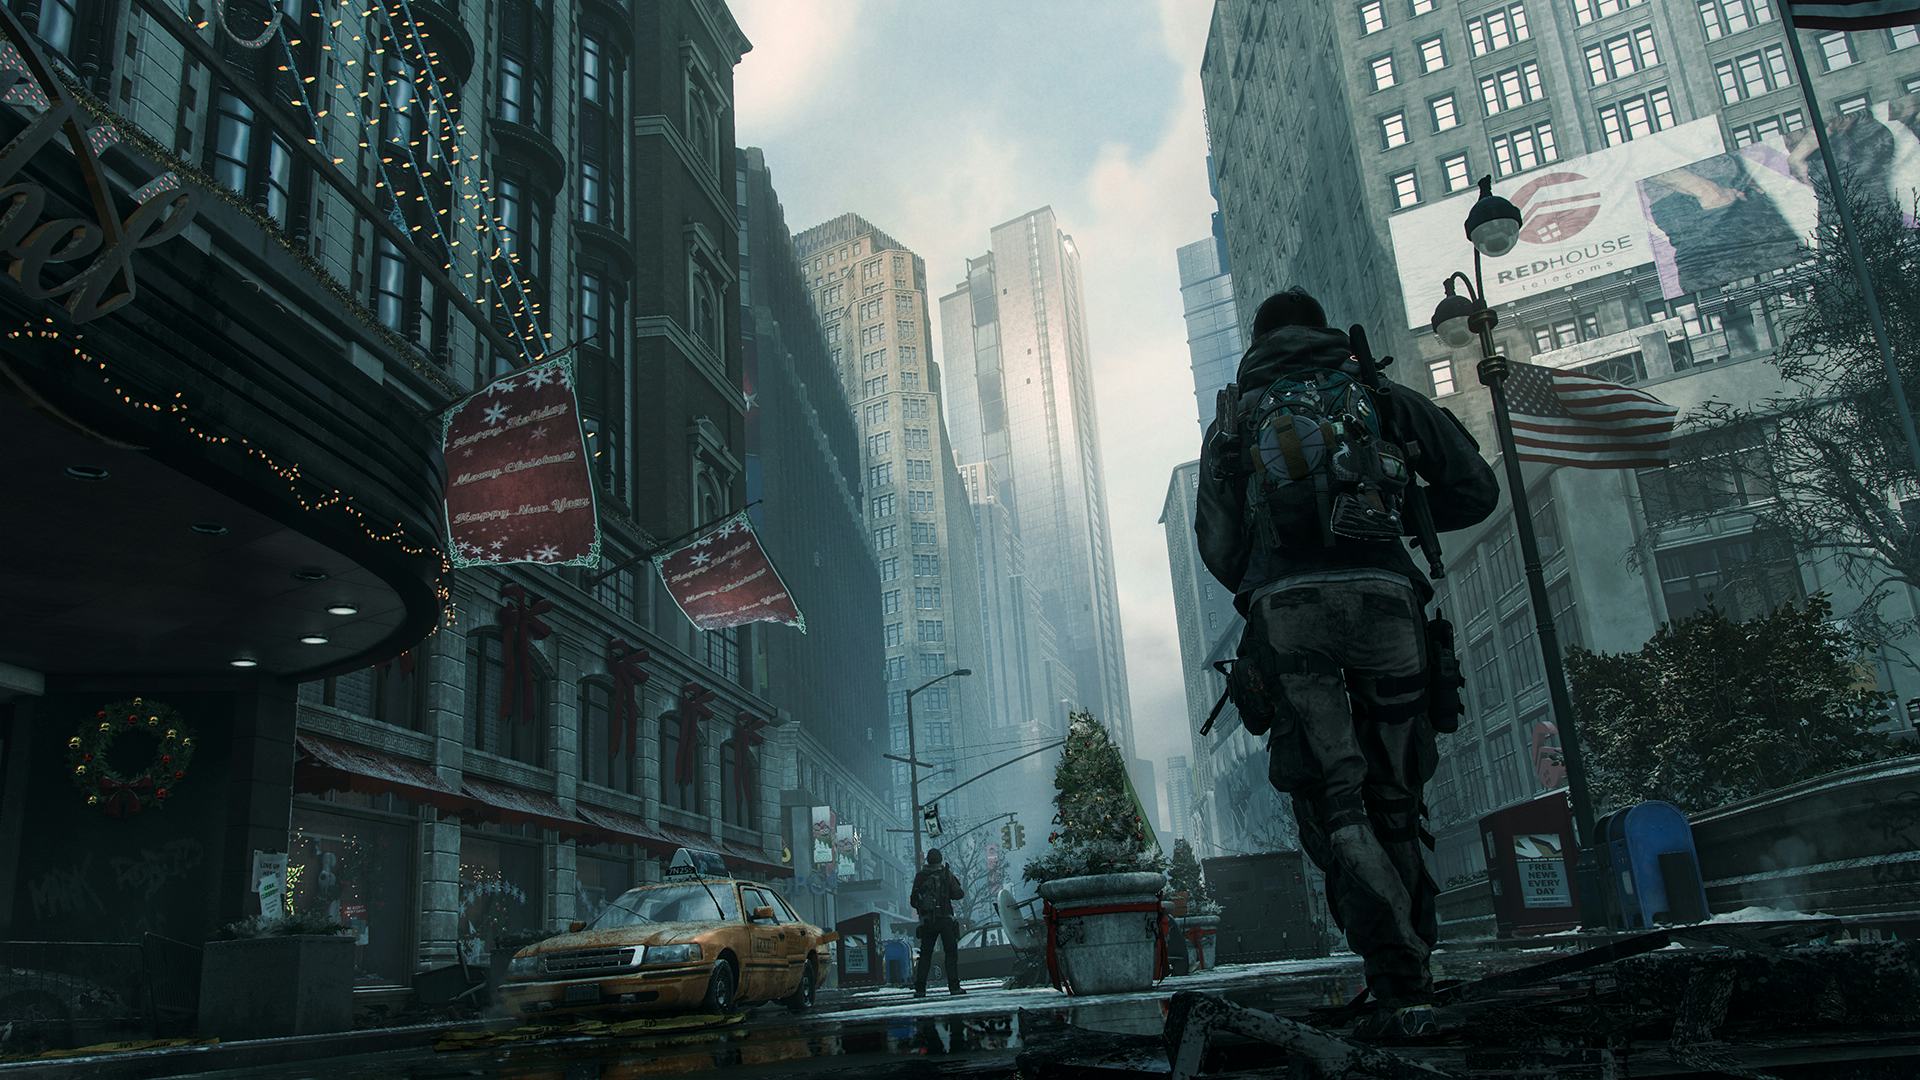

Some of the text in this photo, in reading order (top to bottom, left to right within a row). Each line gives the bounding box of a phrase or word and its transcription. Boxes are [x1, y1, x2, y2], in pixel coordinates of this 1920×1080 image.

[1497, 234, 1633, 284] REDHOUSE
[1522, 260, 1613, 291] telecoms
[452, 426, 503, 449] Happy
[452, 450, 576, 487] Merry Christmas
[453, 509, 509, 524] Happy
[518, 504, 549, 515] New
[1528, 871, 1558, 879] NEWS
[1529, 863, 1554, 871] FREE
[1528, 879, 1560, 887] EVERY
[1536, 887, 1555, 895] DAY
